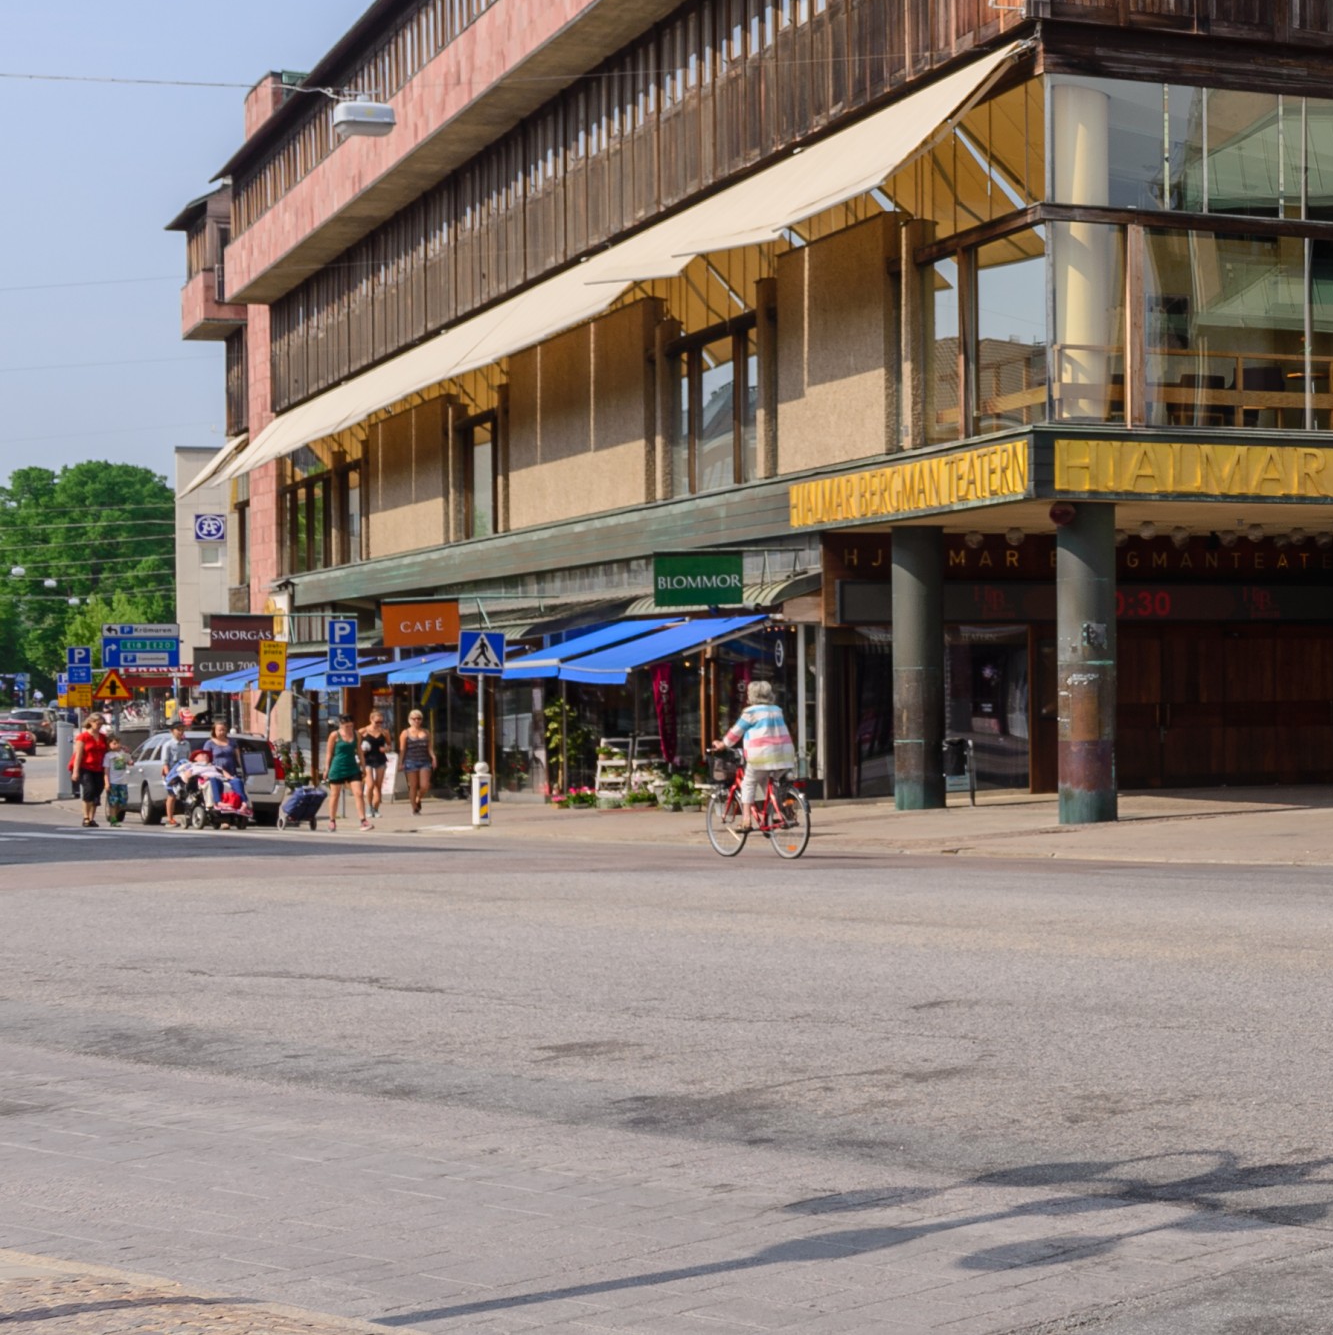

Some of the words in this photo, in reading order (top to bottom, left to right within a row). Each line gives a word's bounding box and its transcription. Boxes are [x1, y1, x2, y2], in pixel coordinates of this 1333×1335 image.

[1056, 441, 1332, 497] HJALMAR
[790, 474, 858, 527] HJALMAR
[859, 458, 942, 516] BERGMAN
[944, 440, 1028, 504] TEATERN
[844, 548, 1019, 566] HJMAR
[657, 574, 741, 590] BLOMMOR
[334, 623, 350, 643] P
[400, 617, 444, 633] CAFÉ
[211, 629, 272, 640] SMÖRGÅS
[74, 648, 86, 663] P
[200, 661, 235, 672] CLUB
